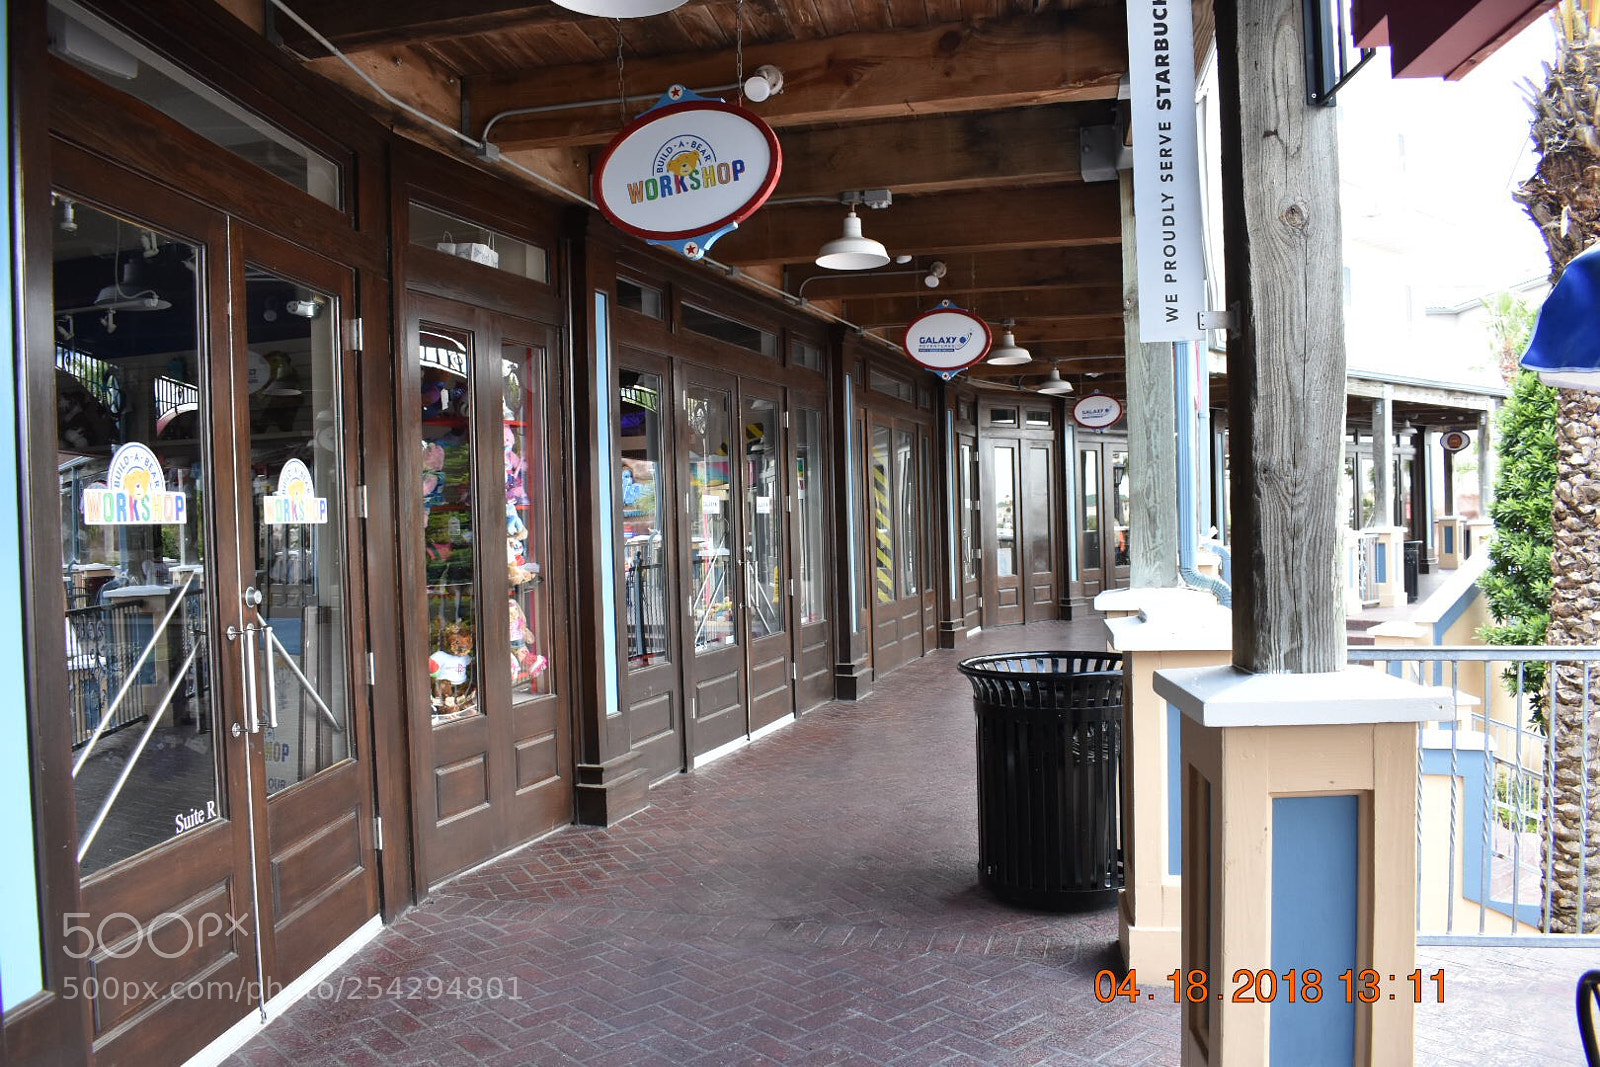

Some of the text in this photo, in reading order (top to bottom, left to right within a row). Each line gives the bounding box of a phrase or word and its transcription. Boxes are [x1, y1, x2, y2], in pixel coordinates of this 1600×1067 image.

[1158, 121, 1173, 182] SERVE
[627, 159, 745, 204] WORKSHOP
[1161, 193, 1178, 283] PROUDLY
[1165, 293, 1179, 323] WE
[919, 336, 957, 344] GALAXY
[86, 491, 184, 522] WORKSHOP
[175, 800, 217, 834] Suite R
